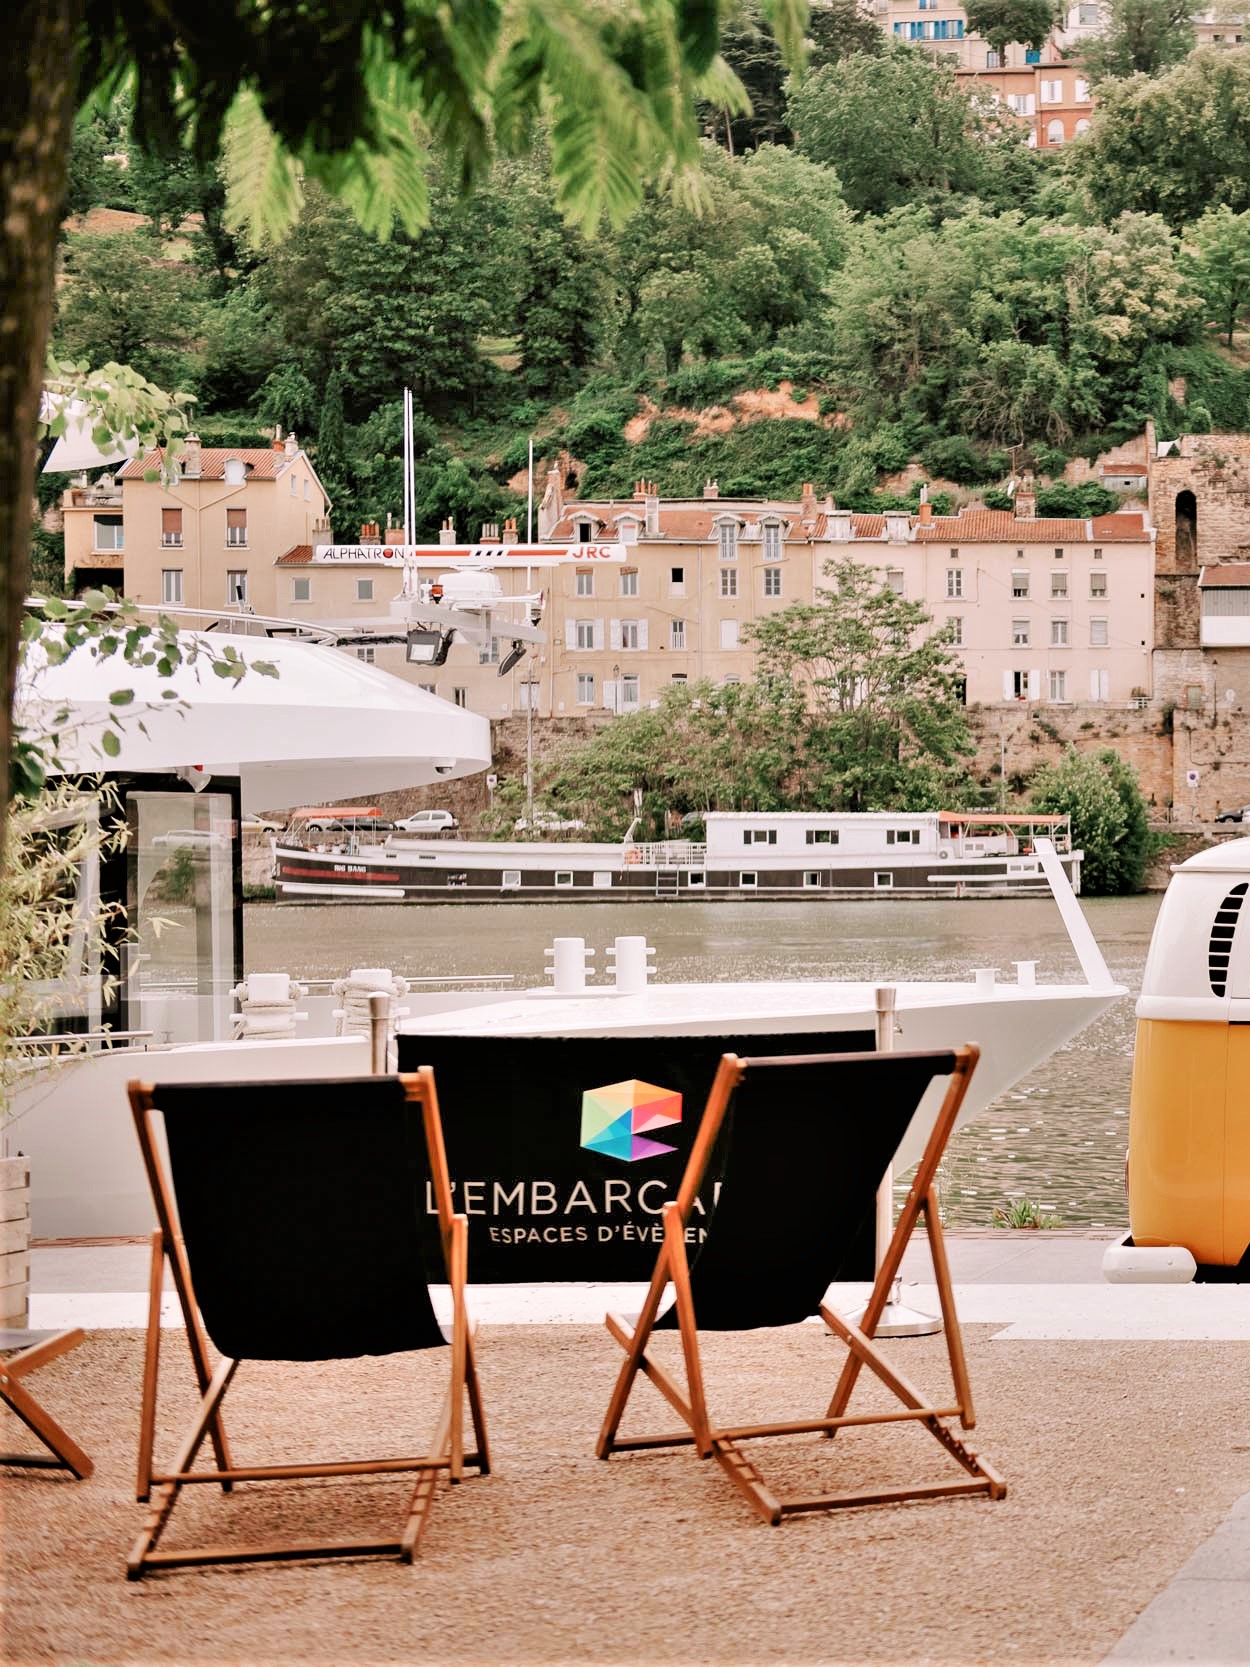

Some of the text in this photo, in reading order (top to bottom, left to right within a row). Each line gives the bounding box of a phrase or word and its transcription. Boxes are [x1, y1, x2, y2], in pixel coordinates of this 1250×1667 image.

[323, 547, 404, 560] ALPHATRON
[572, 546, 612, 559] JRC
[489, 1225, 588, 1244] ESPACES
